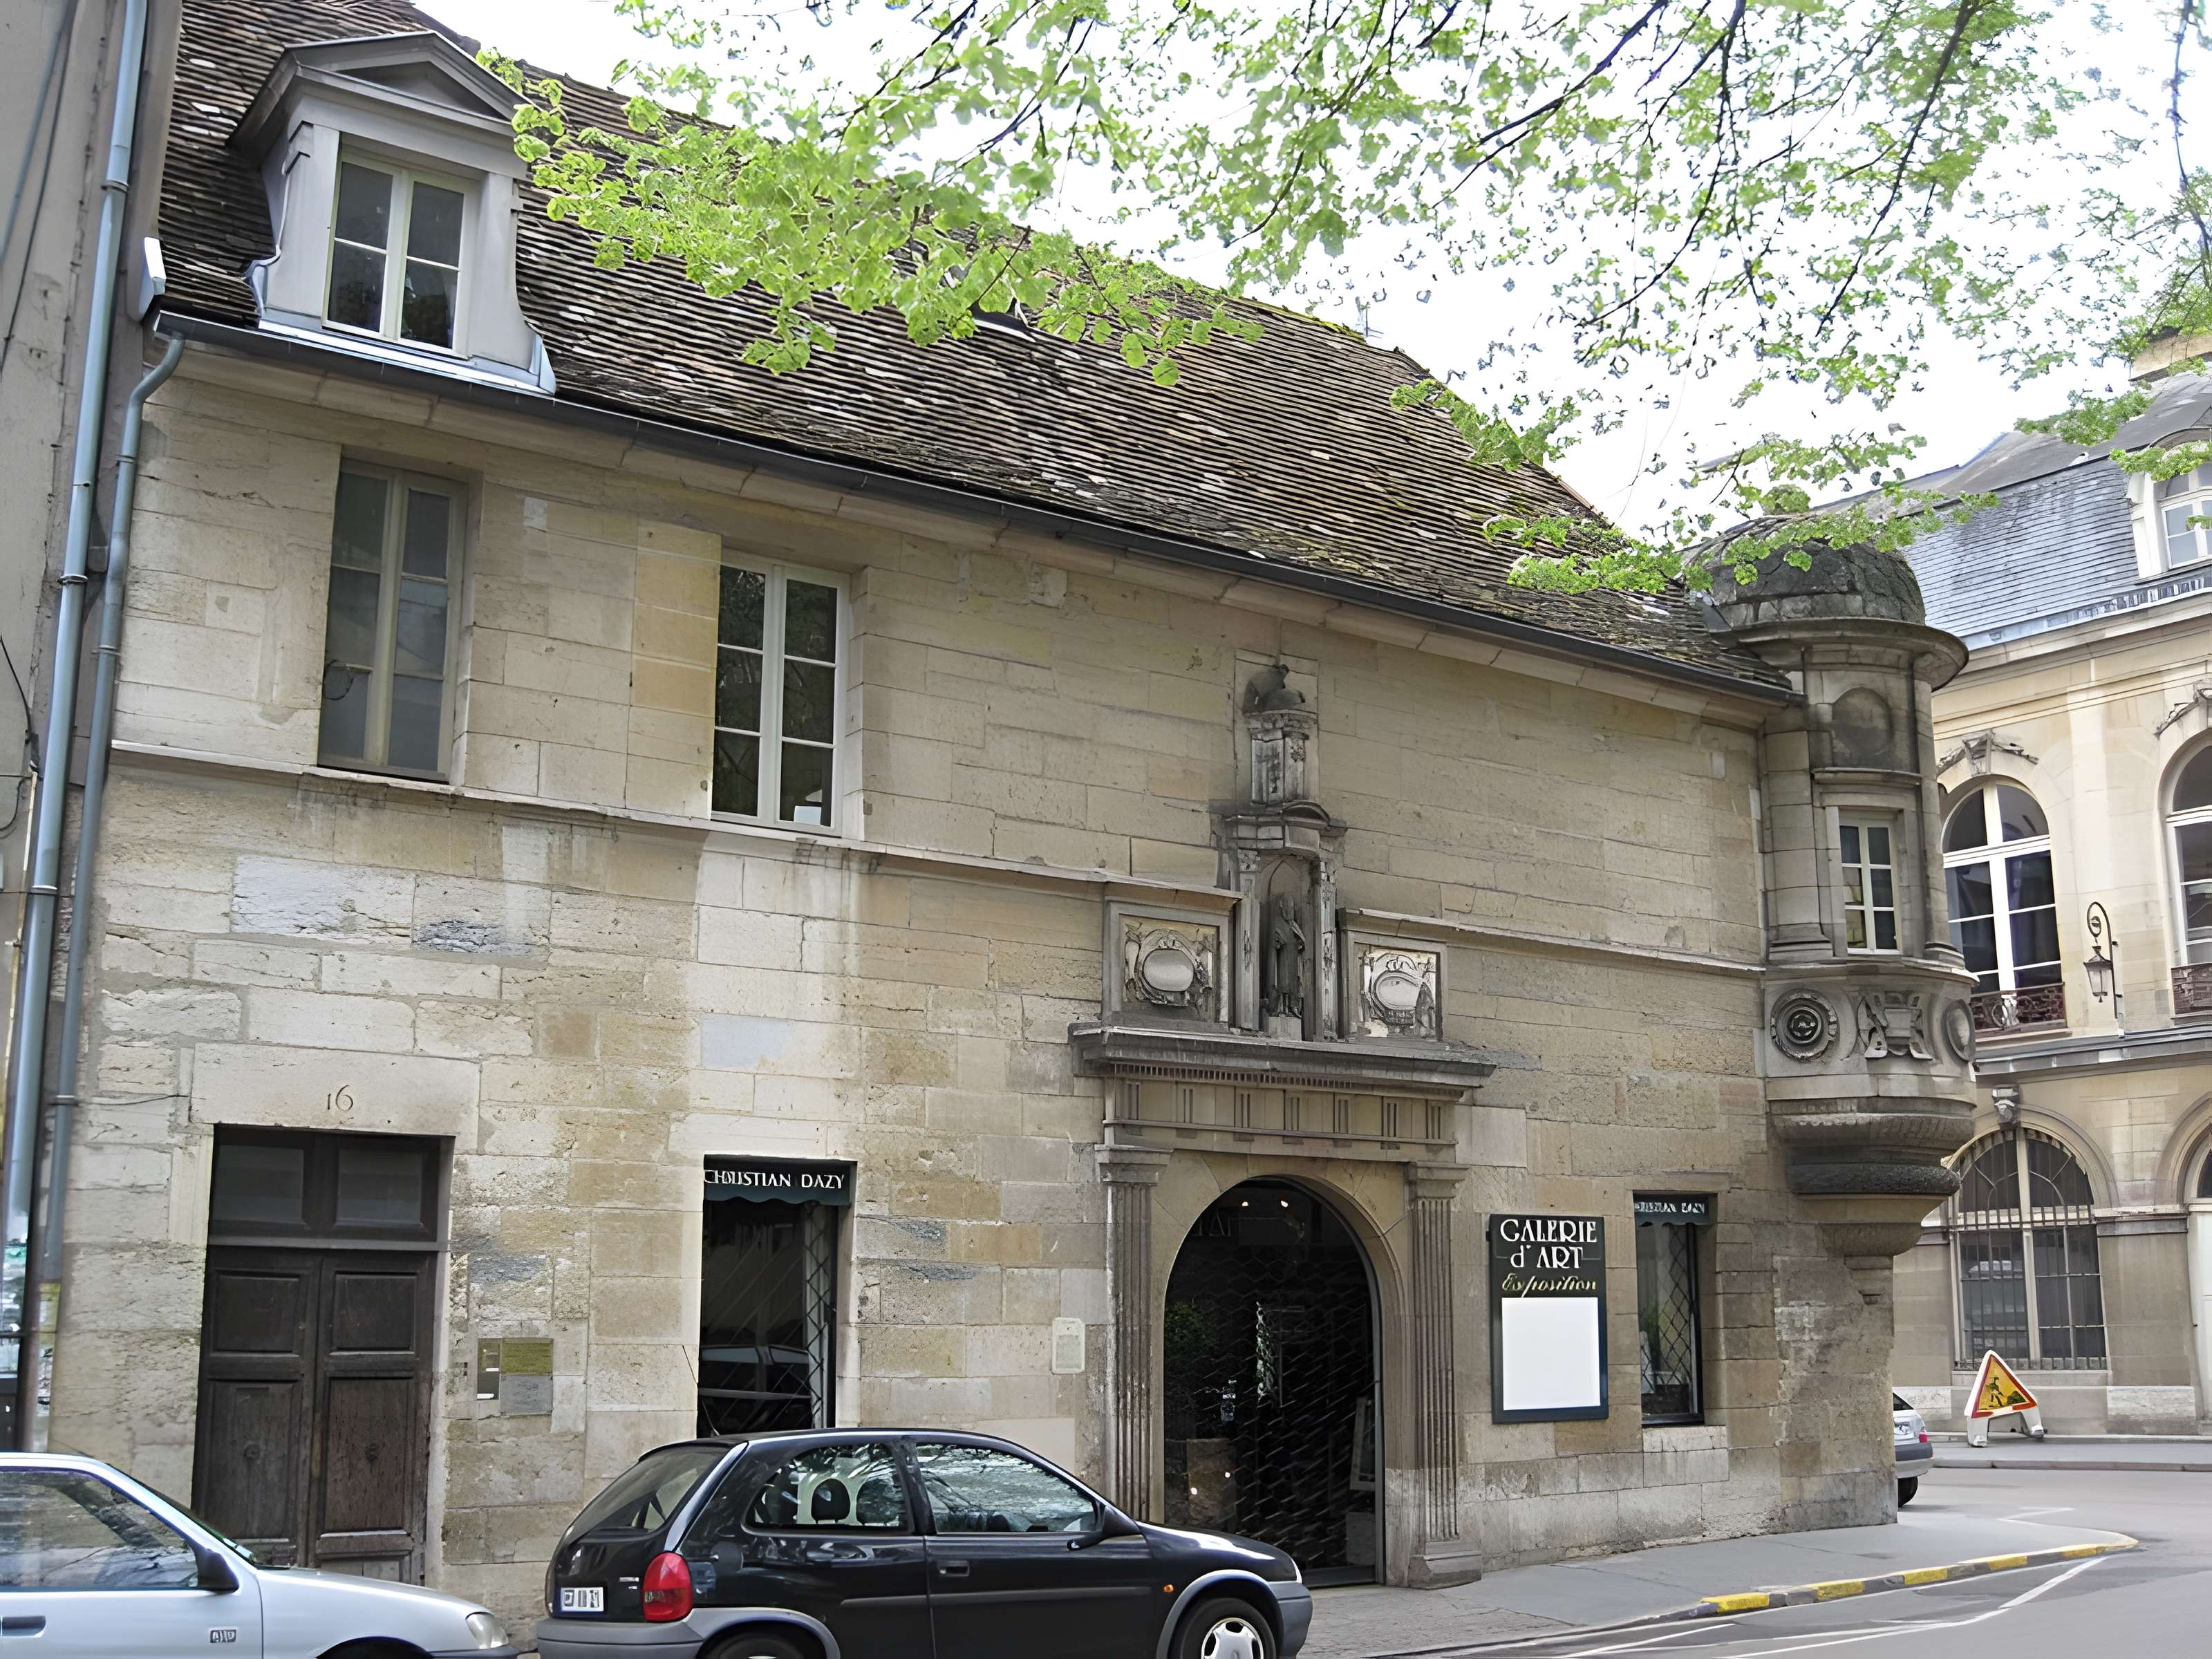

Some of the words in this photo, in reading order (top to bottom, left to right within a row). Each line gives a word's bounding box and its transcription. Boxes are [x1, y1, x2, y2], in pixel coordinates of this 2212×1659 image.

[327, 1084, 354, 1112] 16
[801, 1174, 845, 1189] DAZY
[1500, 1219, 1597, 1243] GALERIE
